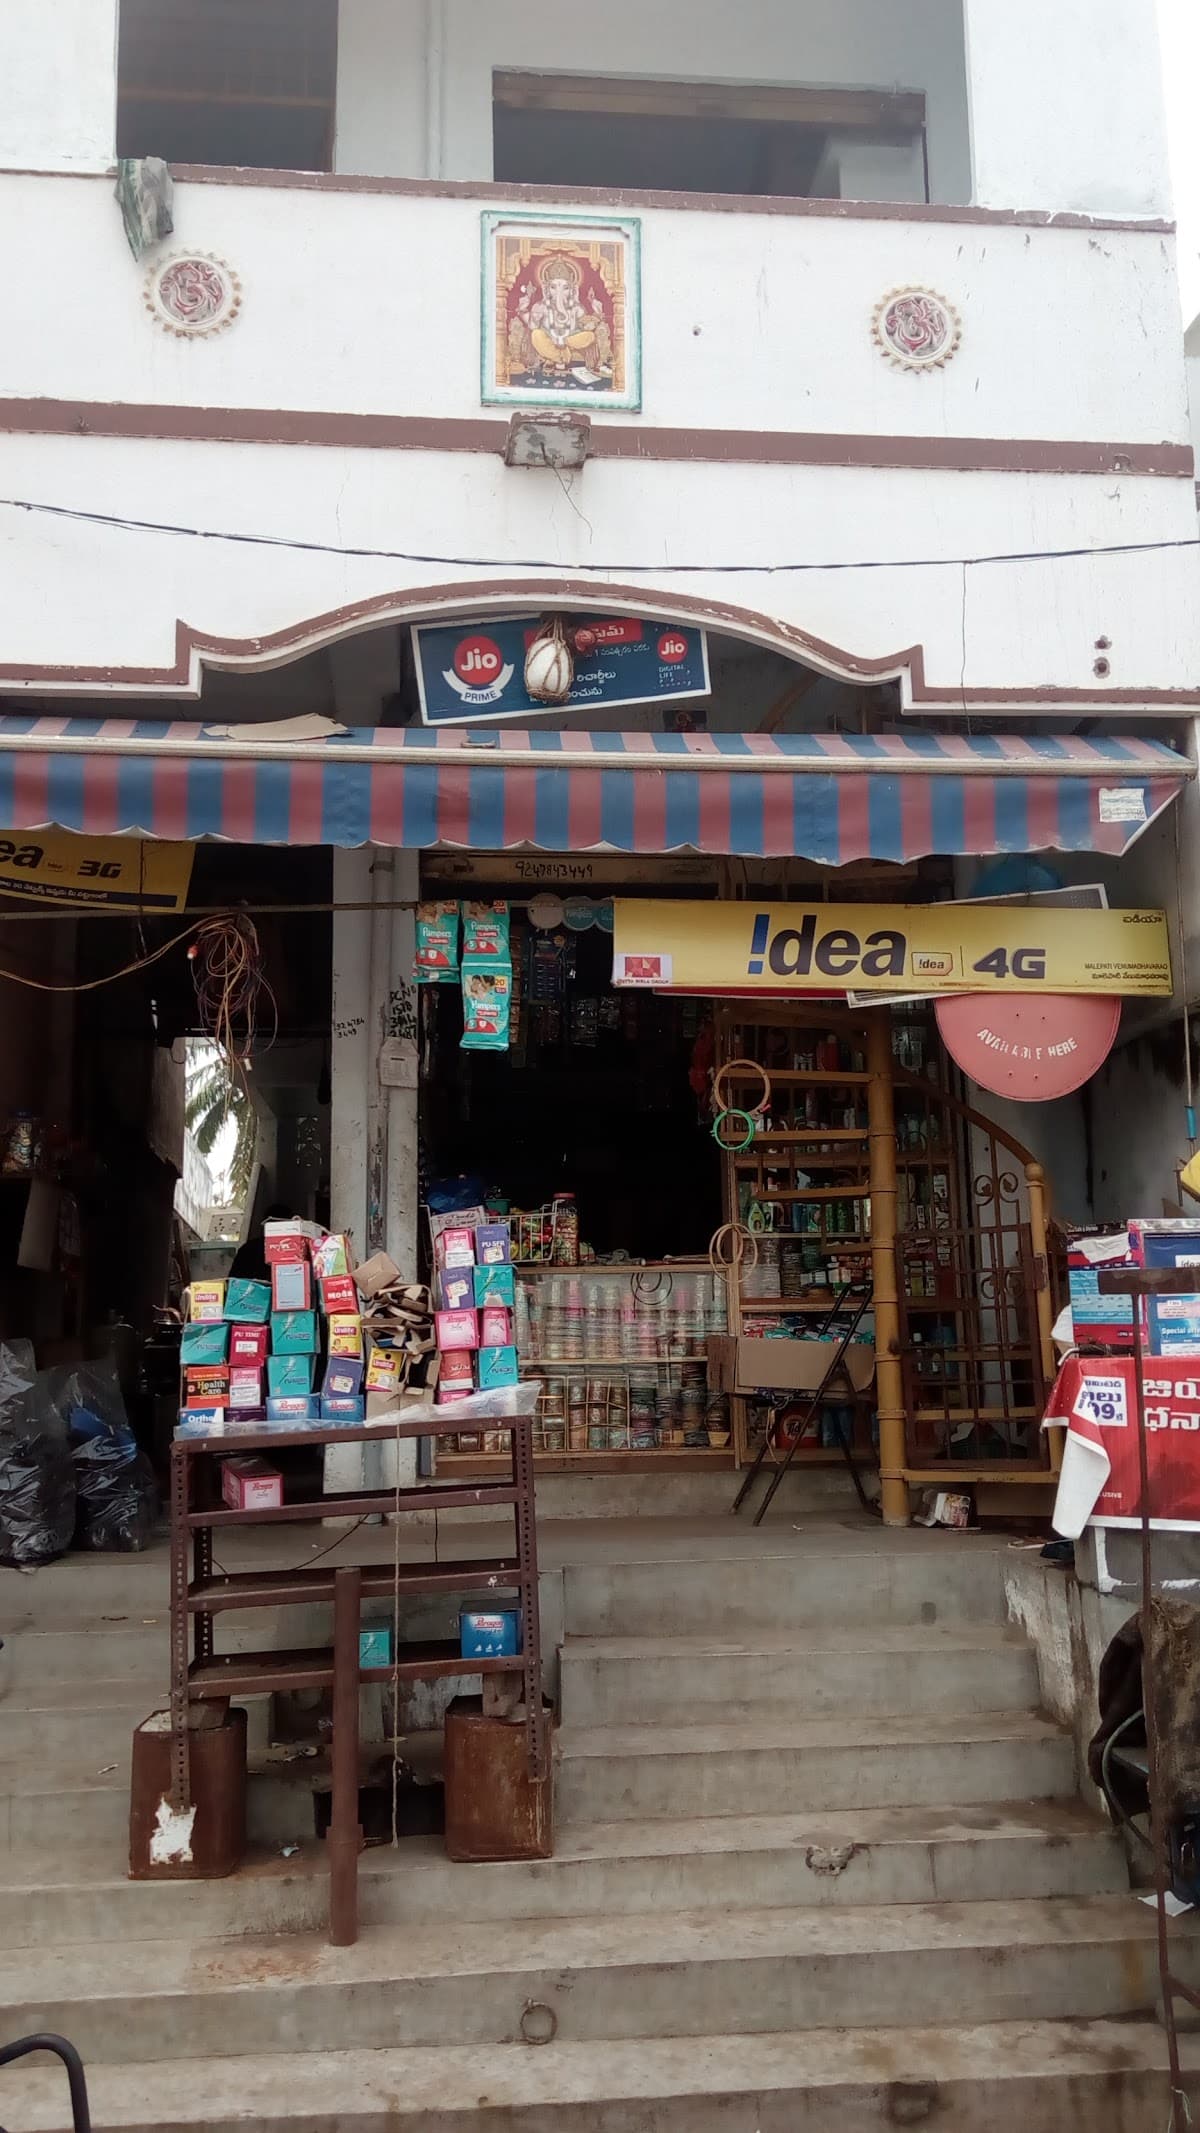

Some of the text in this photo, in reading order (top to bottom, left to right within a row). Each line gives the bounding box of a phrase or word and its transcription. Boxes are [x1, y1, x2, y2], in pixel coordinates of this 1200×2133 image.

[661, 641, 685, 656] Jio
[460, 648, 498, 671] Jio
[464, 691, 497, 702] PRIME
[78, 860, 122, 879] 3G
[514, 861, 594, 879] 9247843449
[422, 927, 452, 938] Pampers
[471, 922, 500, 934] Pampers
[973, 947, 1046, 979] 4G
[471, 1000, 501, 1011] Pampers
[1047, 1037, 1078, 1057] HERE
[1161, 1327, 1186, 1337] Special
[197, 1381, 225, 1390] Health
[200, 1388, 222, 1396] Care
